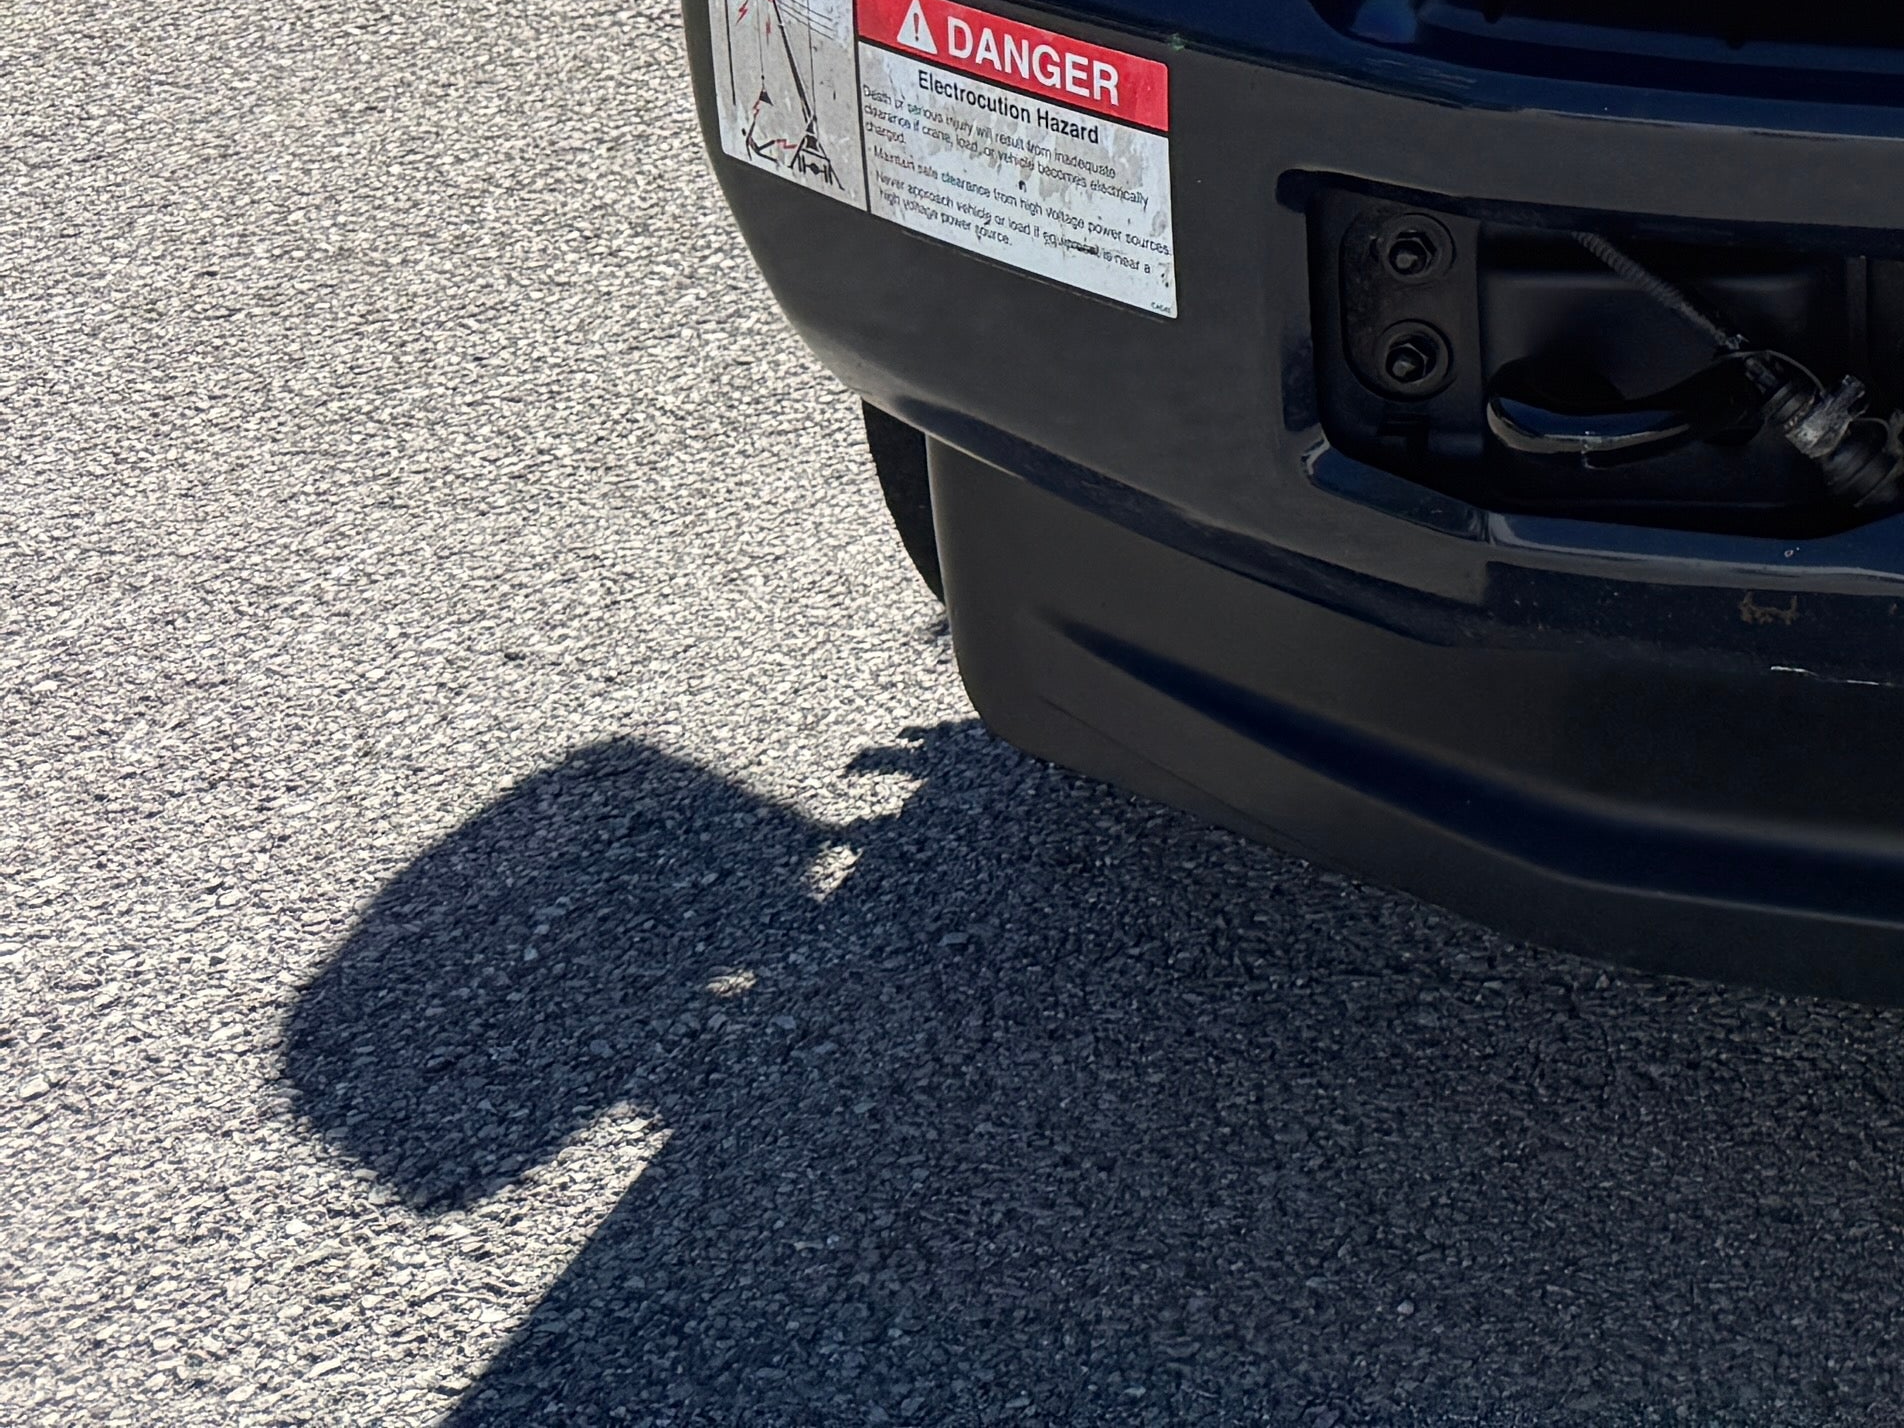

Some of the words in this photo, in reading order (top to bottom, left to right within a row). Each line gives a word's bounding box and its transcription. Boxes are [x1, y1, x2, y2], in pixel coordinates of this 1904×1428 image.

[947, 15, 1120, 107] DANGER
[917, 69, 1031, 124] Electrocution
[1037, 107, 1099, 144] Hazard
[1027, 139, 1050, 159] from
[1054, 147, 1116, 179] inadequate
[1008, 215, 1031, 236] load
